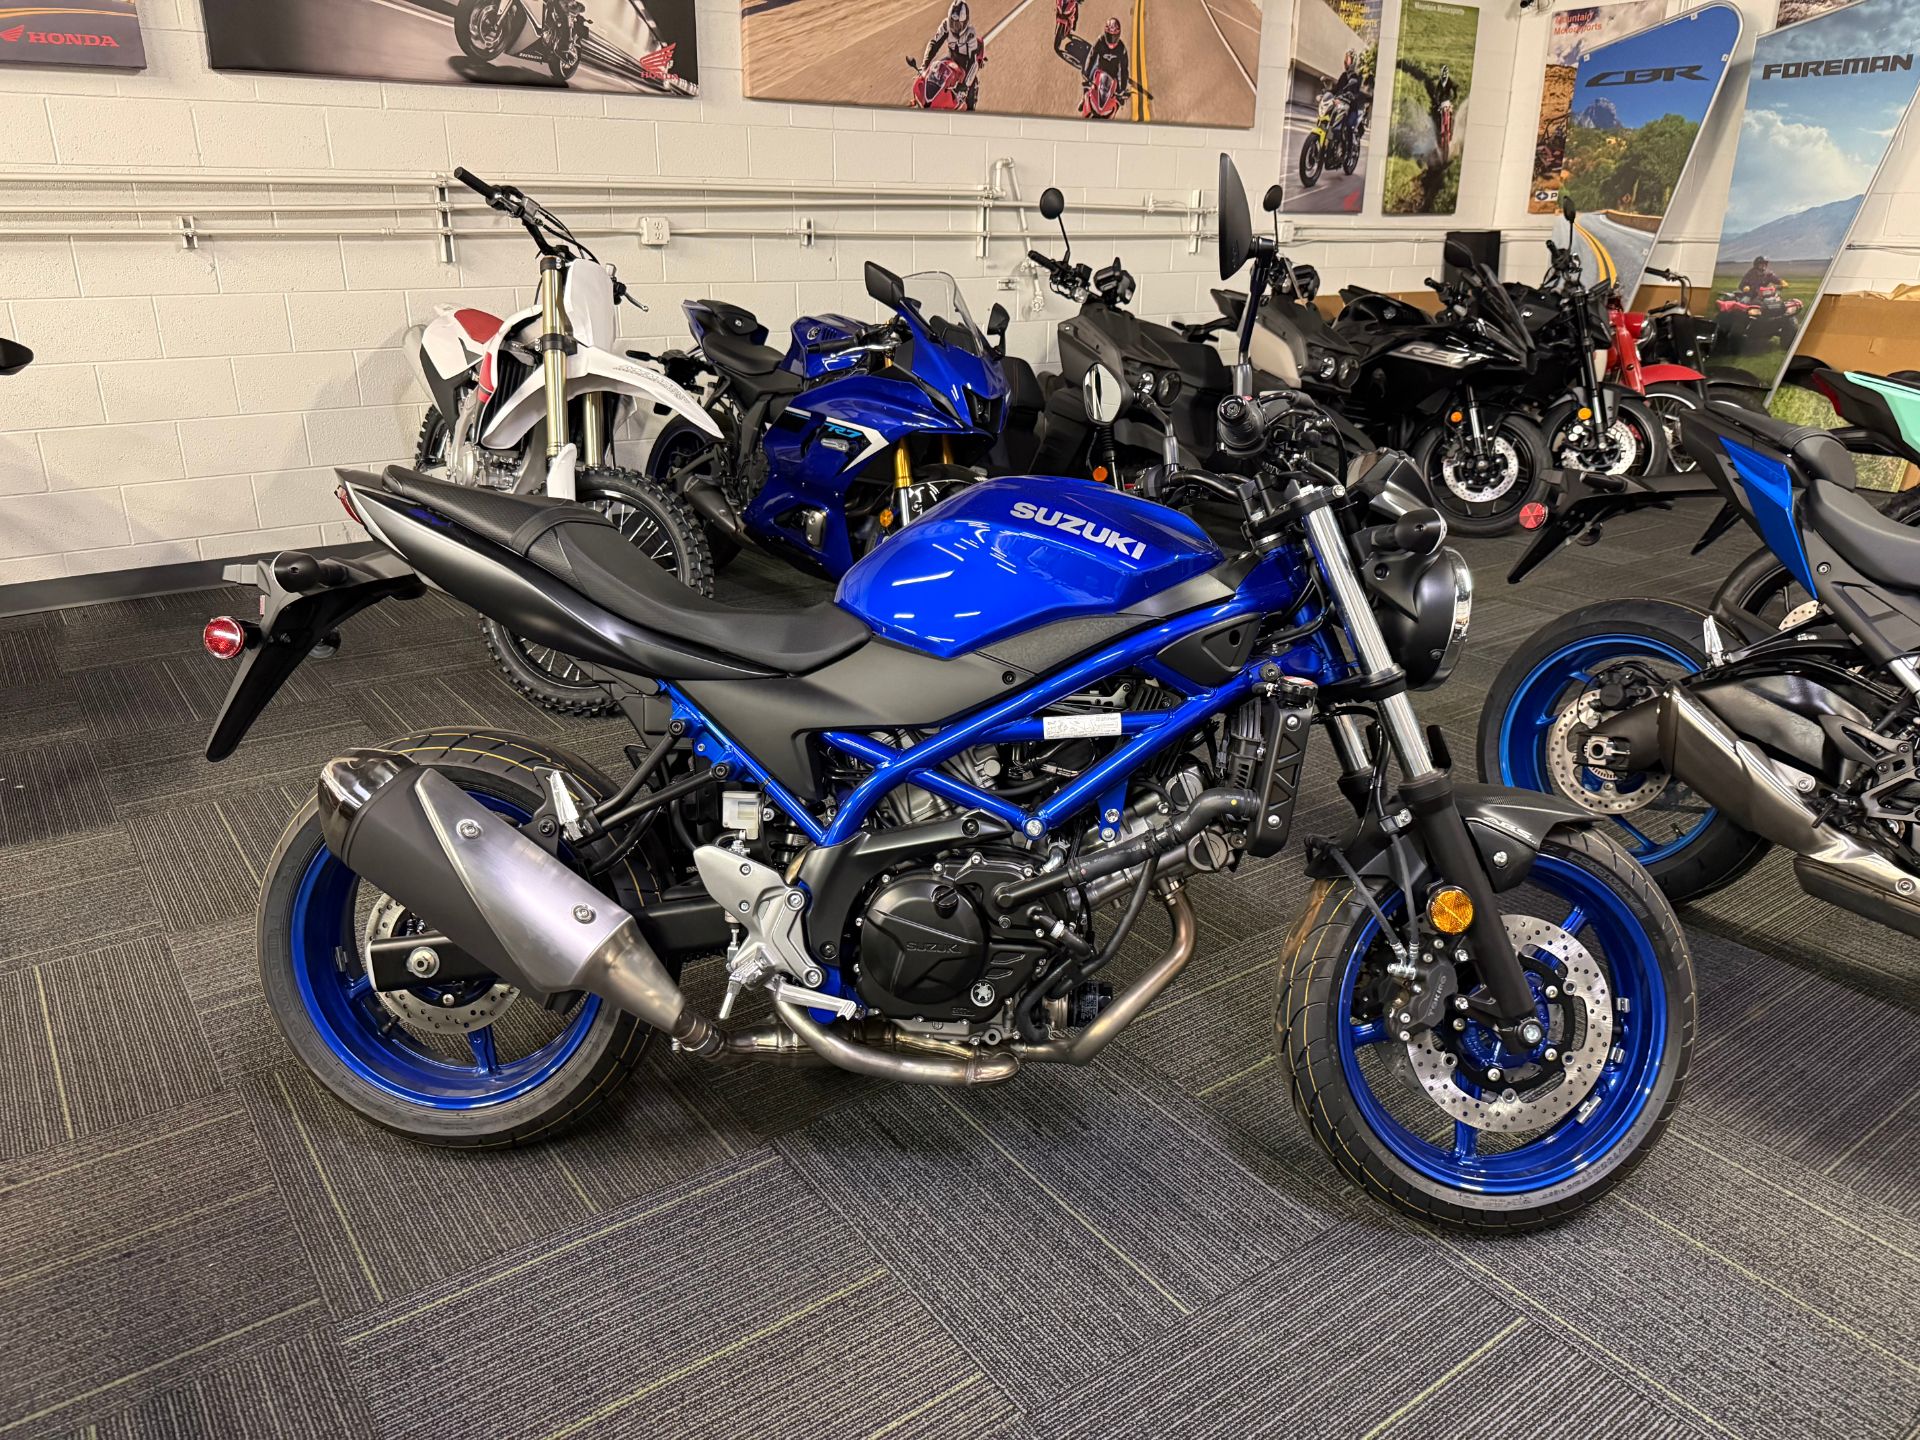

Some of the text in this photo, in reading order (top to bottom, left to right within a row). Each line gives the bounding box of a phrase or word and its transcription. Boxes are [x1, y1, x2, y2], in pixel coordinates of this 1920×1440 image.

[27, 31, 119, 47] HONDA
[1585, 65, 1710, 88] CBR
[1762, 54, 1914, 80] FOREMAN
[827, 425, 863, 439] R7
[1010, 501, 1147, 560] SUZUKI
[1427, 975, 1447, 1017] TOKICO
